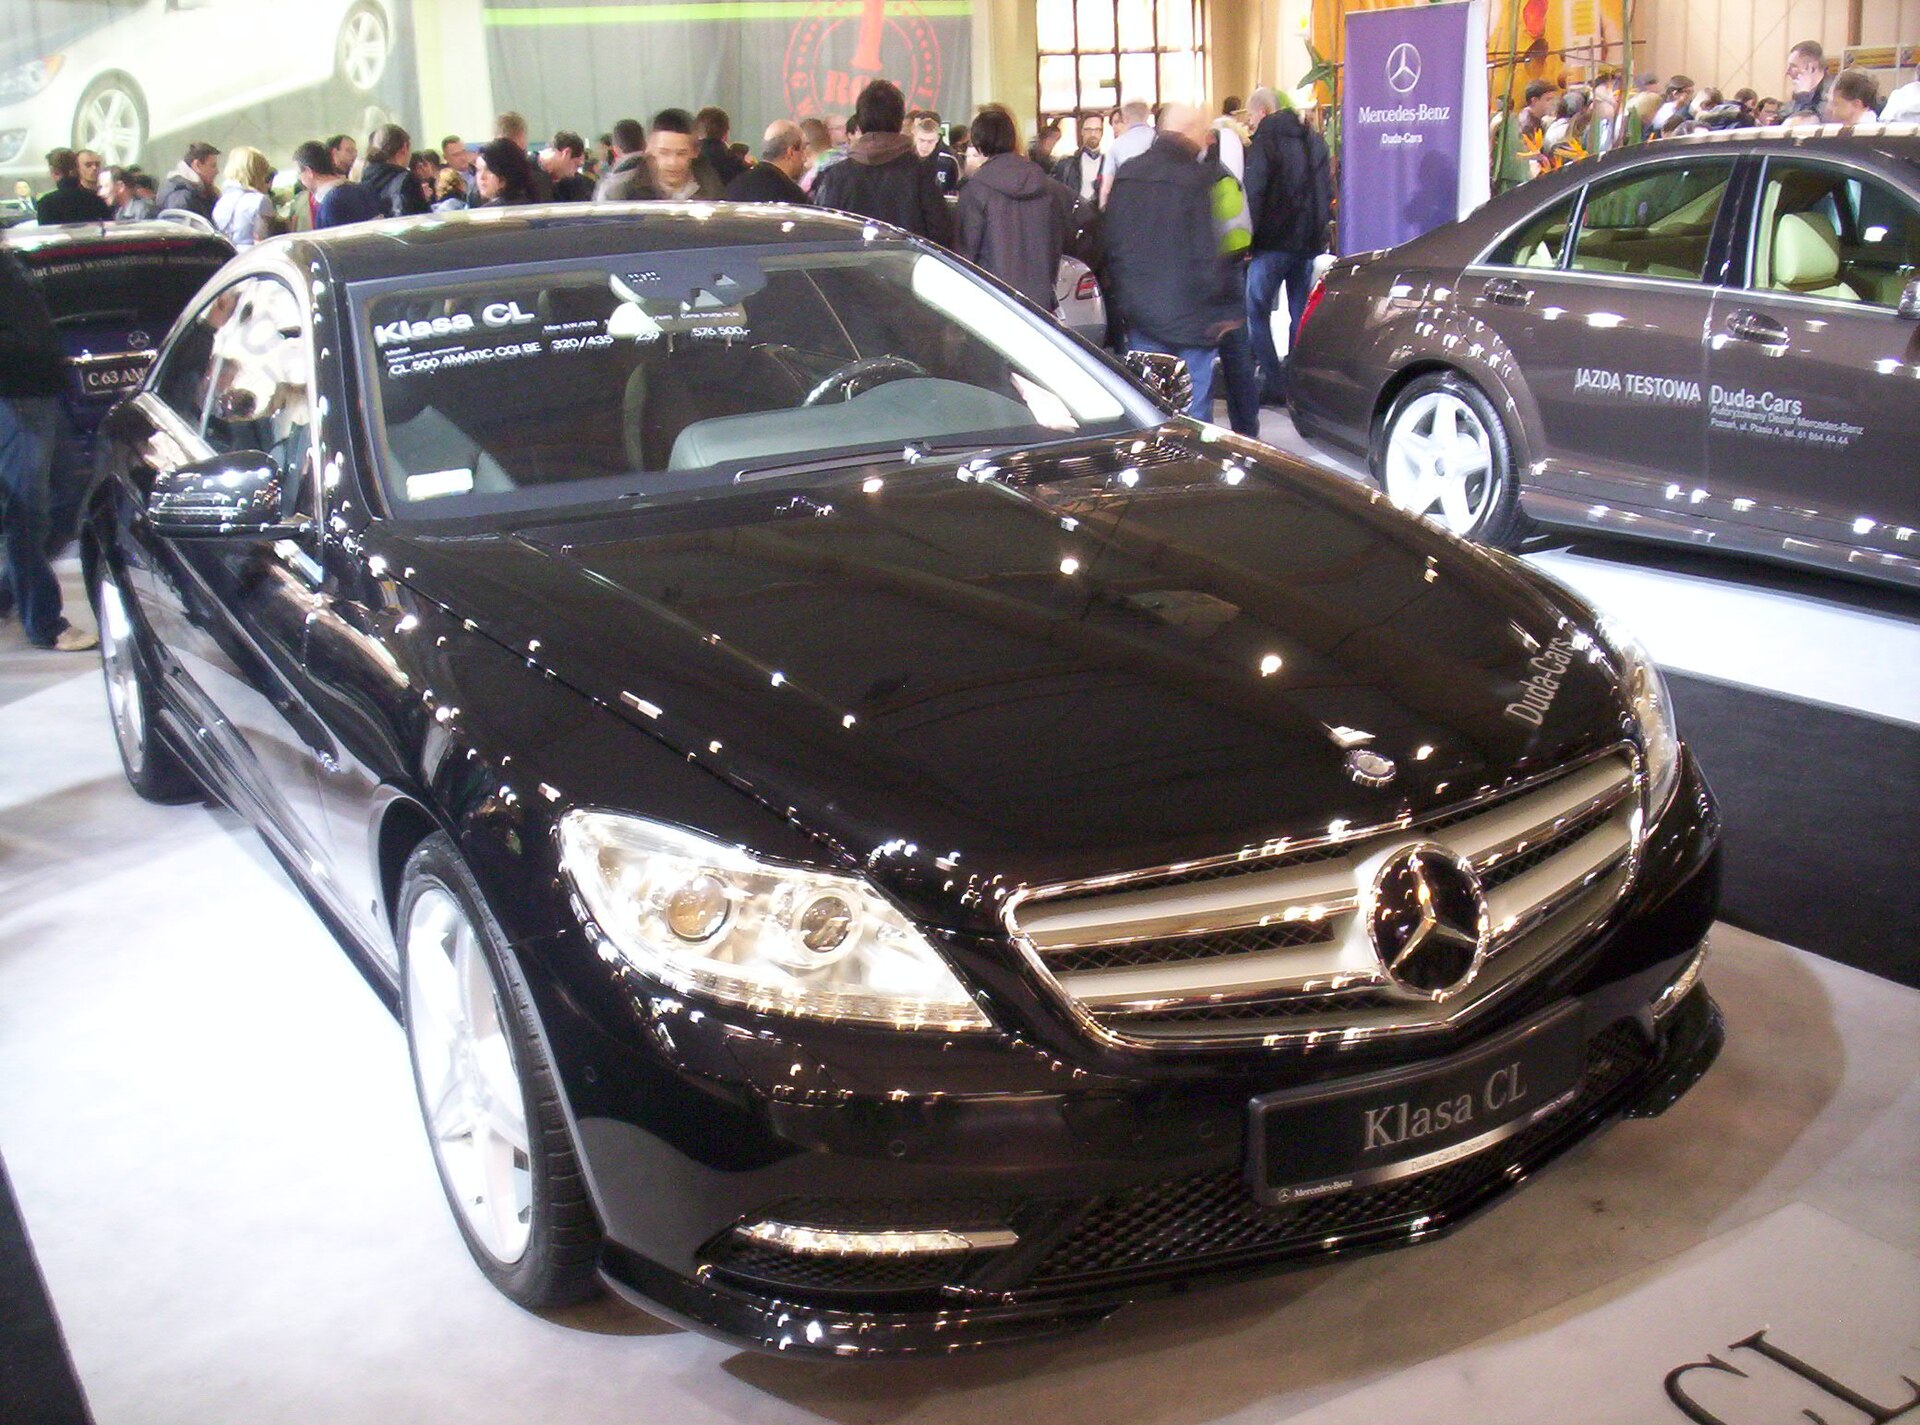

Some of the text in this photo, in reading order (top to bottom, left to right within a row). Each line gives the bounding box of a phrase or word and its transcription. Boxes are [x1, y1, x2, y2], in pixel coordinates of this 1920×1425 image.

[1359, 103, 1450, 123] Mercedes-Benz
[1381, 132, 1423, 144] Duda-Cars
[374, 301, 535, 347] Klasa CL
[692, 326, 717, 337] 576
[389, 364, 411, 376] CL
[412, 357, 440, 371] 500
[442, 348, 495, 365] 4MATIC
[495, 345, 521, 358] CGI
[522, 342, 543, 353] BE
[551, 334, 614, 350] 320/435
[87, 367, 147, 386] C 63 AM
[1575, 368, 1702, 402] JAZDA TESTOWA
[1710, 384, 1803, 415] Duda-Cars
[1797, 416, 1865, 435] Mercedes-Benz
[1504, 637, 1574, 727] Duda-Cars
[1363, 1092, 1473, 1151] Klasa
[1484, 1061, 1528, 1111] CL
[1294, 1179, 1353, 1198] Mercedes-Benz
[1664, 1330, 1920, 1425] CL
